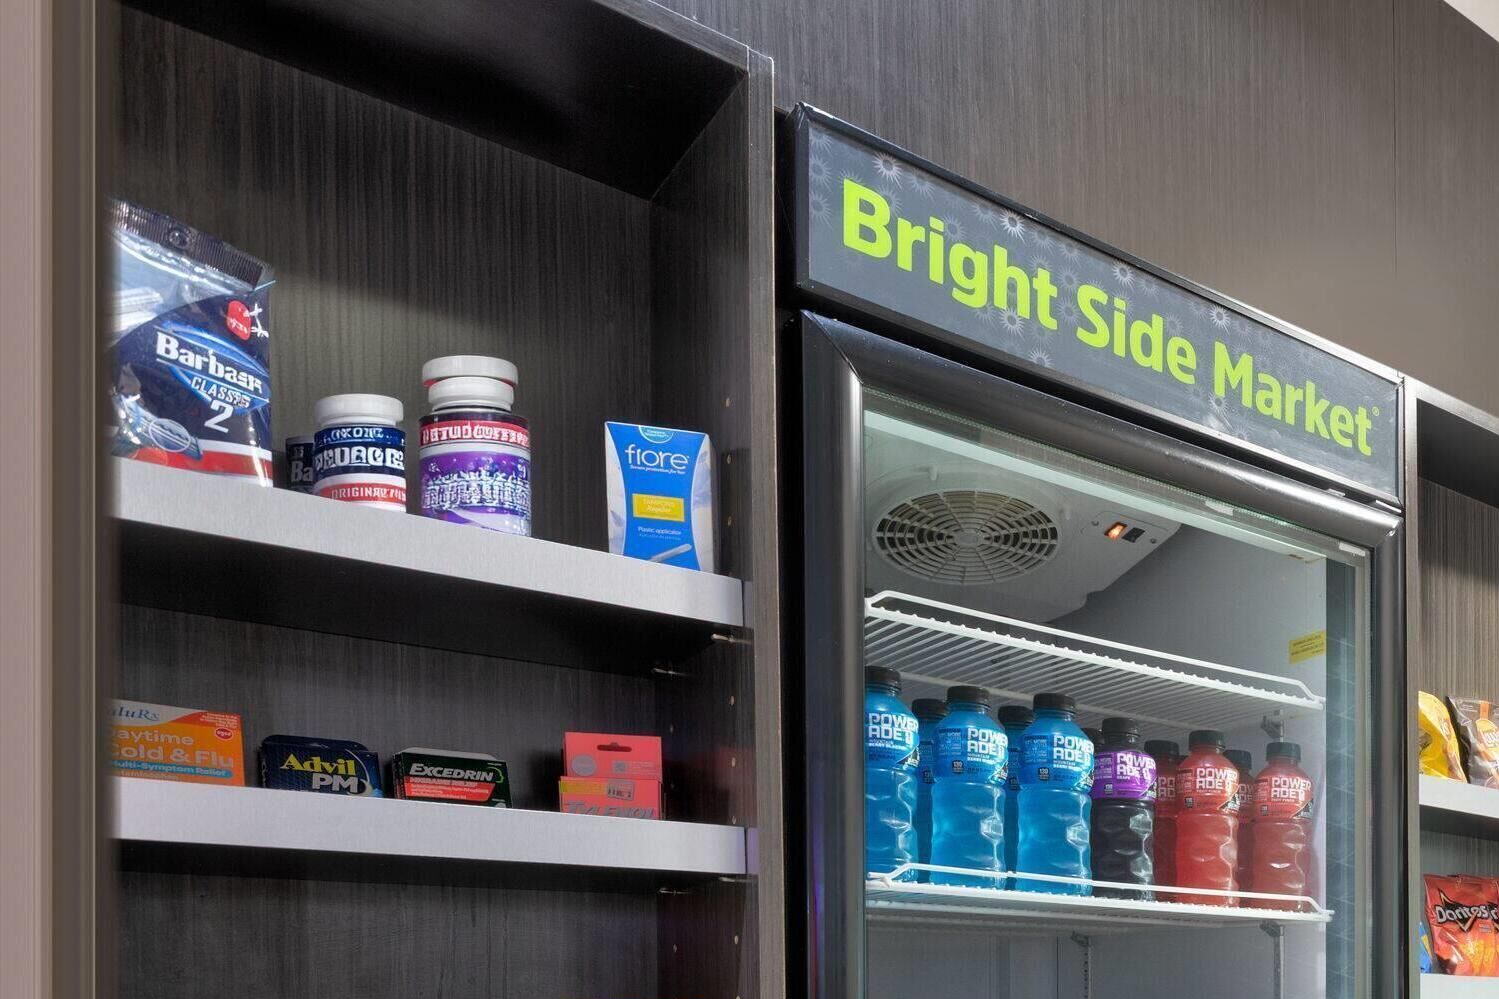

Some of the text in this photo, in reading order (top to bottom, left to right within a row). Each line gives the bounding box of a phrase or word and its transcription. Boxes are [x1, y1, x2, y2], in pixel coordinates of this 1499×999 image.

[843, 177, 1057, 330] Bright
[1077, 284, 1196, 384] Side
[204, 400, 234, 433] 2
[625, 444, 689, 470] fiore
[113, 729, 194, 746] aytime
[114, 760, 194, 775] ulti-Symptom
[171, 748, 189, 763] &
[195, 750, 234, 768] Flu
[280, 753, 356, 776] Advil
[311, 773, 359, 793] PM
[1196, 768, 1238, 781] POWER
[1196, 778, 1223, 790] ADE
[1271, 777, 1312, 791] POWER
[1271, 788, 1297, 799] ADE
[1435, 905, 1488, 925] Doritos
